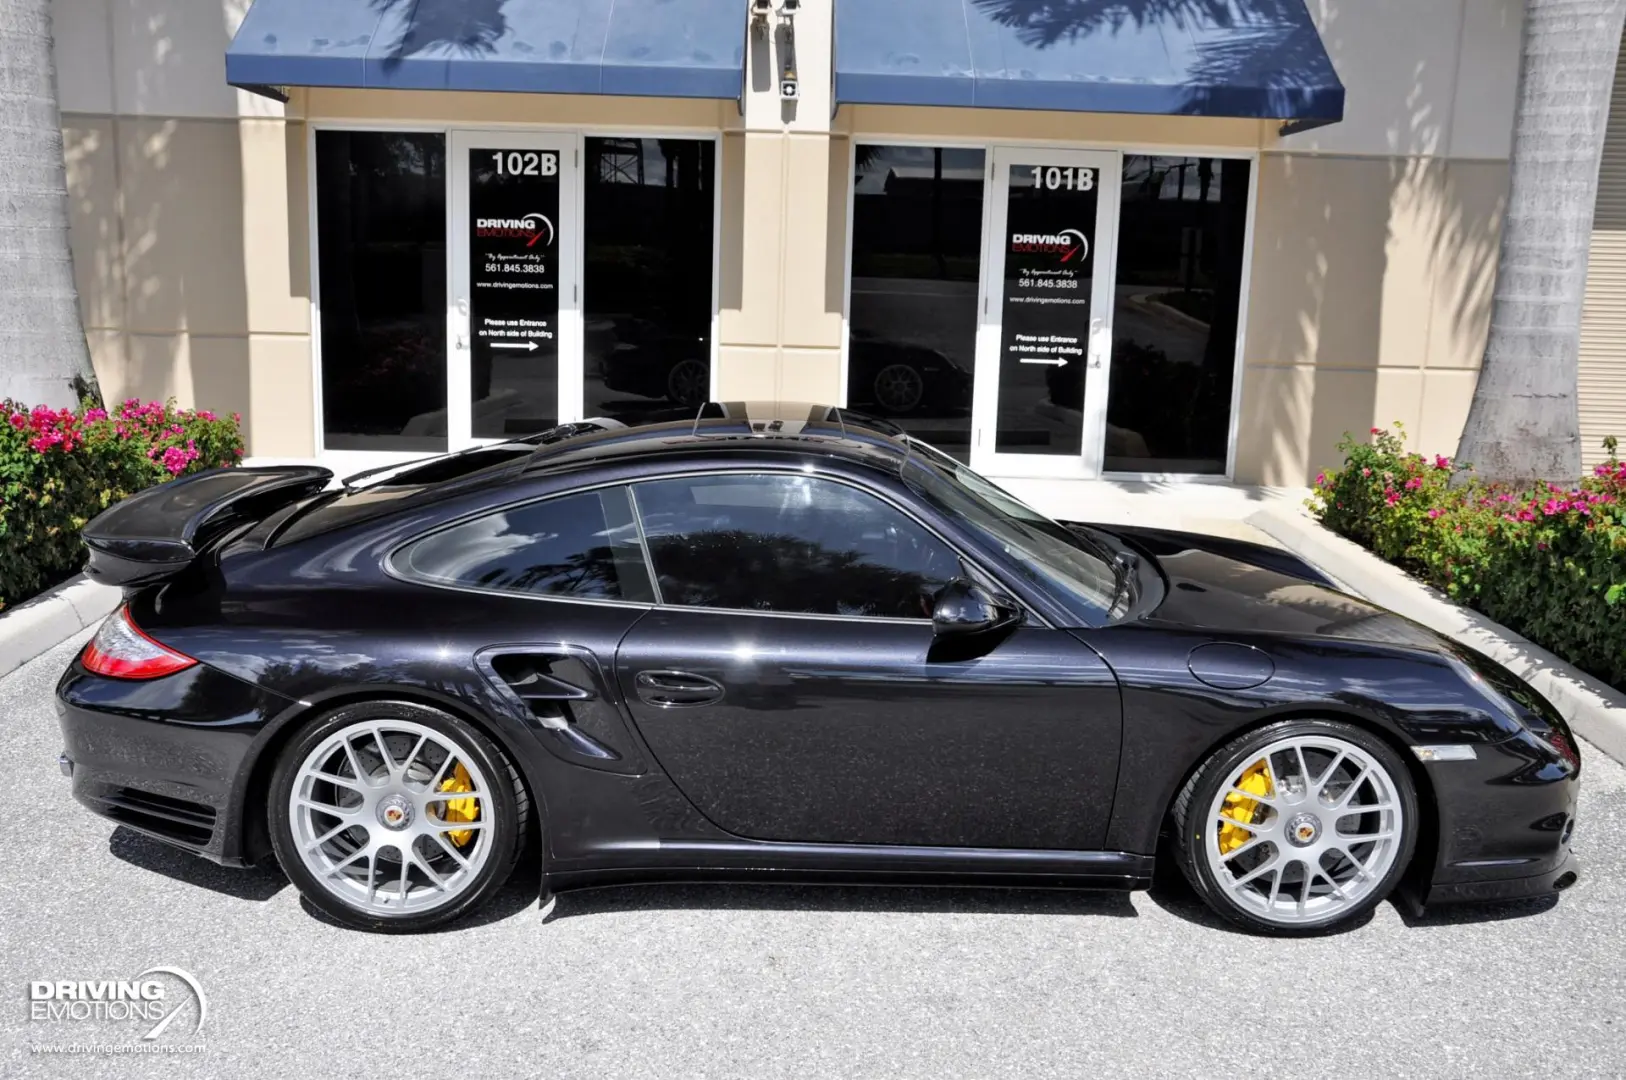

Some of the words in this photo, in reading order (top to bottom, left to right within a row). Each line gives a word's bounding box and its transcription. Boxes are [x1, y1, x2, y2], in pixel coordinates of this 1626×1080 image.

[492, 152, 557, 176] 102B
[1031, 166, 1094, 191] 101B
[477, 218, 535, 229] DRIVING
[477, 228, 535, 238] EMOTIONS
[1012, 234, 1071, 245] DRIVING
[1012, 244, 1070, 253] EMOTIONS
[485, 263, 545, 273] 561.845.3838
[1018, 278, 1078, 288] 561.845.3838
[1009, 296, 1086, 304] www.drivingemotions.com
[484, 318, 506, 326] Please
[519, 319, 547, 327] Entrance
[488, 329, 505, 337] North
[528, 330, 553, 339] Building
[1015, 334, 1037, 342] Please
[1050, 335, 1078, 343] Entrance
[1037, 345, 1050, 353] side
[1058, 346, 1083, 356] Building
